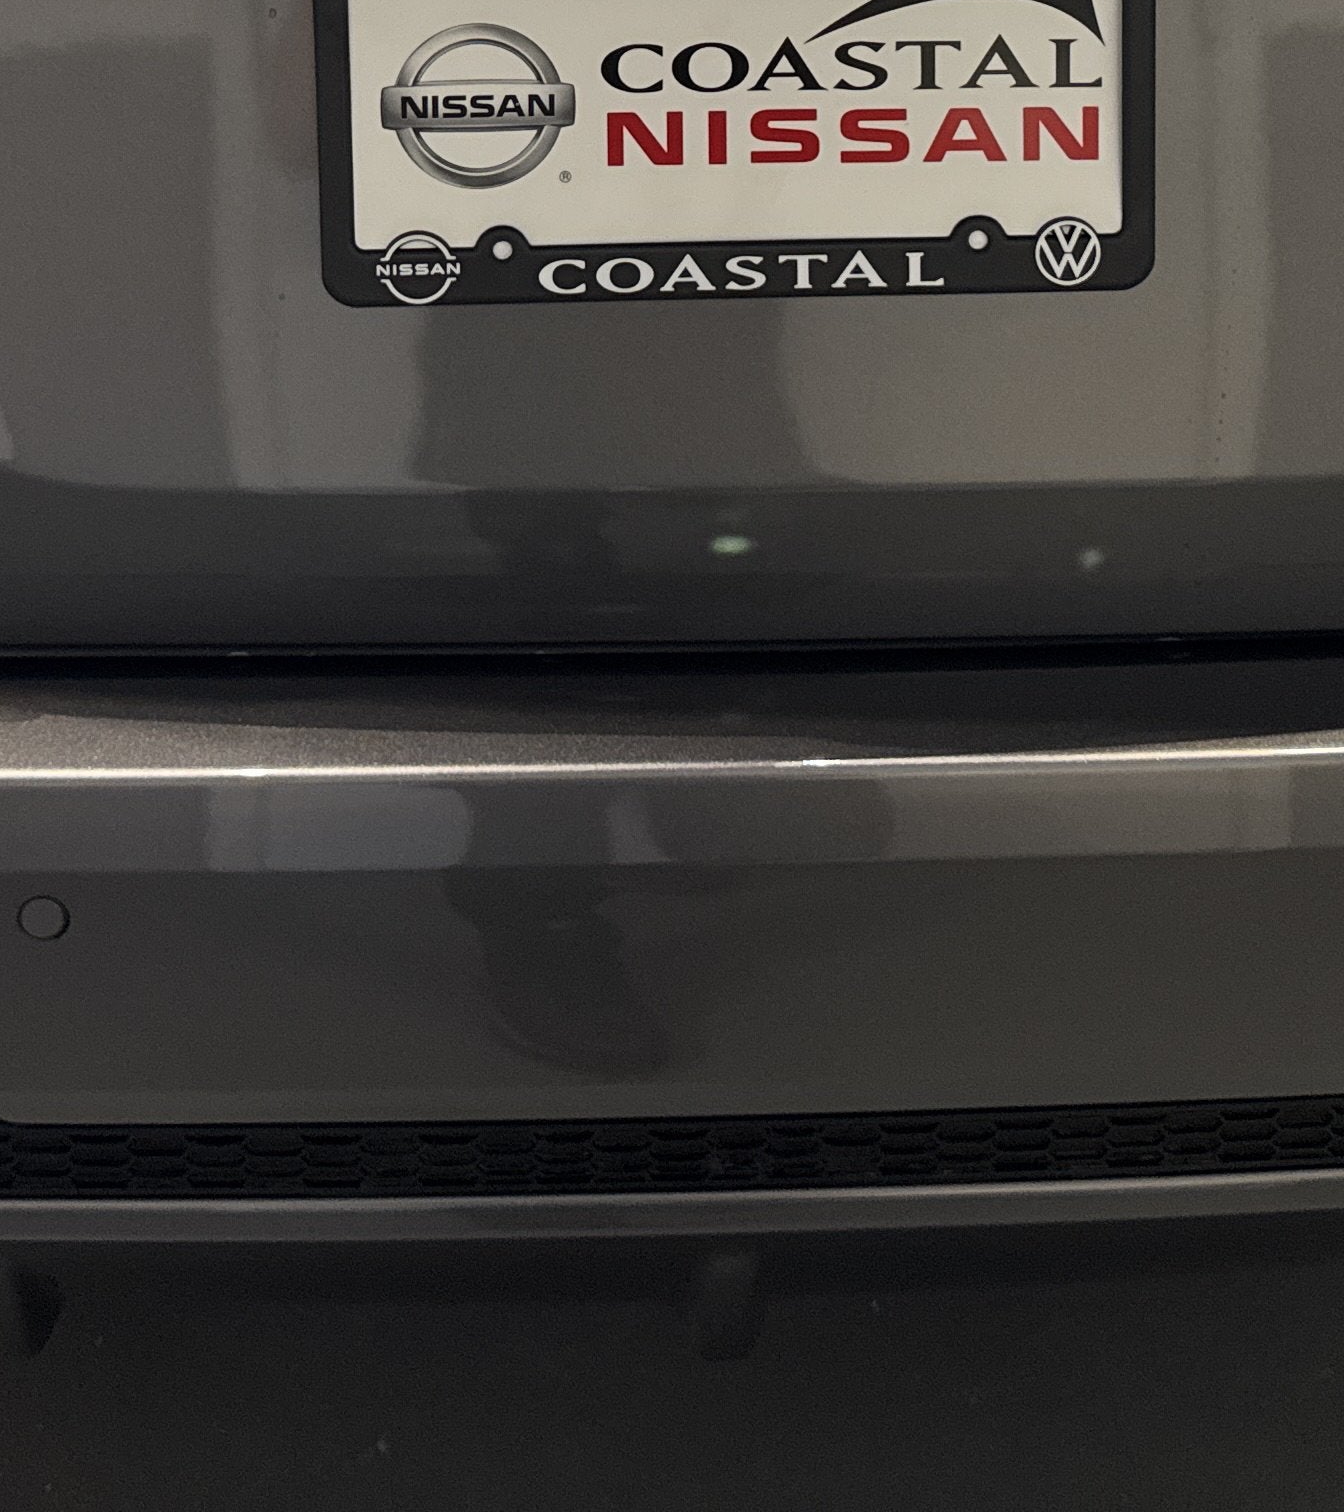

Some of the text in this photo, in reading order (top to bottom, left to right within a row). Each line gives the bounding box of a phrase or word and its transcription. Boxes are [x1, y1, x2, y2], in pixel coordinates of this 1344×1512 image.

[599, 34, 1104, 93] COASTAL
[400, 94, 556, 119] NISSAN
[605, 105, 1101, 167] NISSAN
[376, 262, 461, 277] NISSAN
[537, 249, 946, 294] COASTAL
